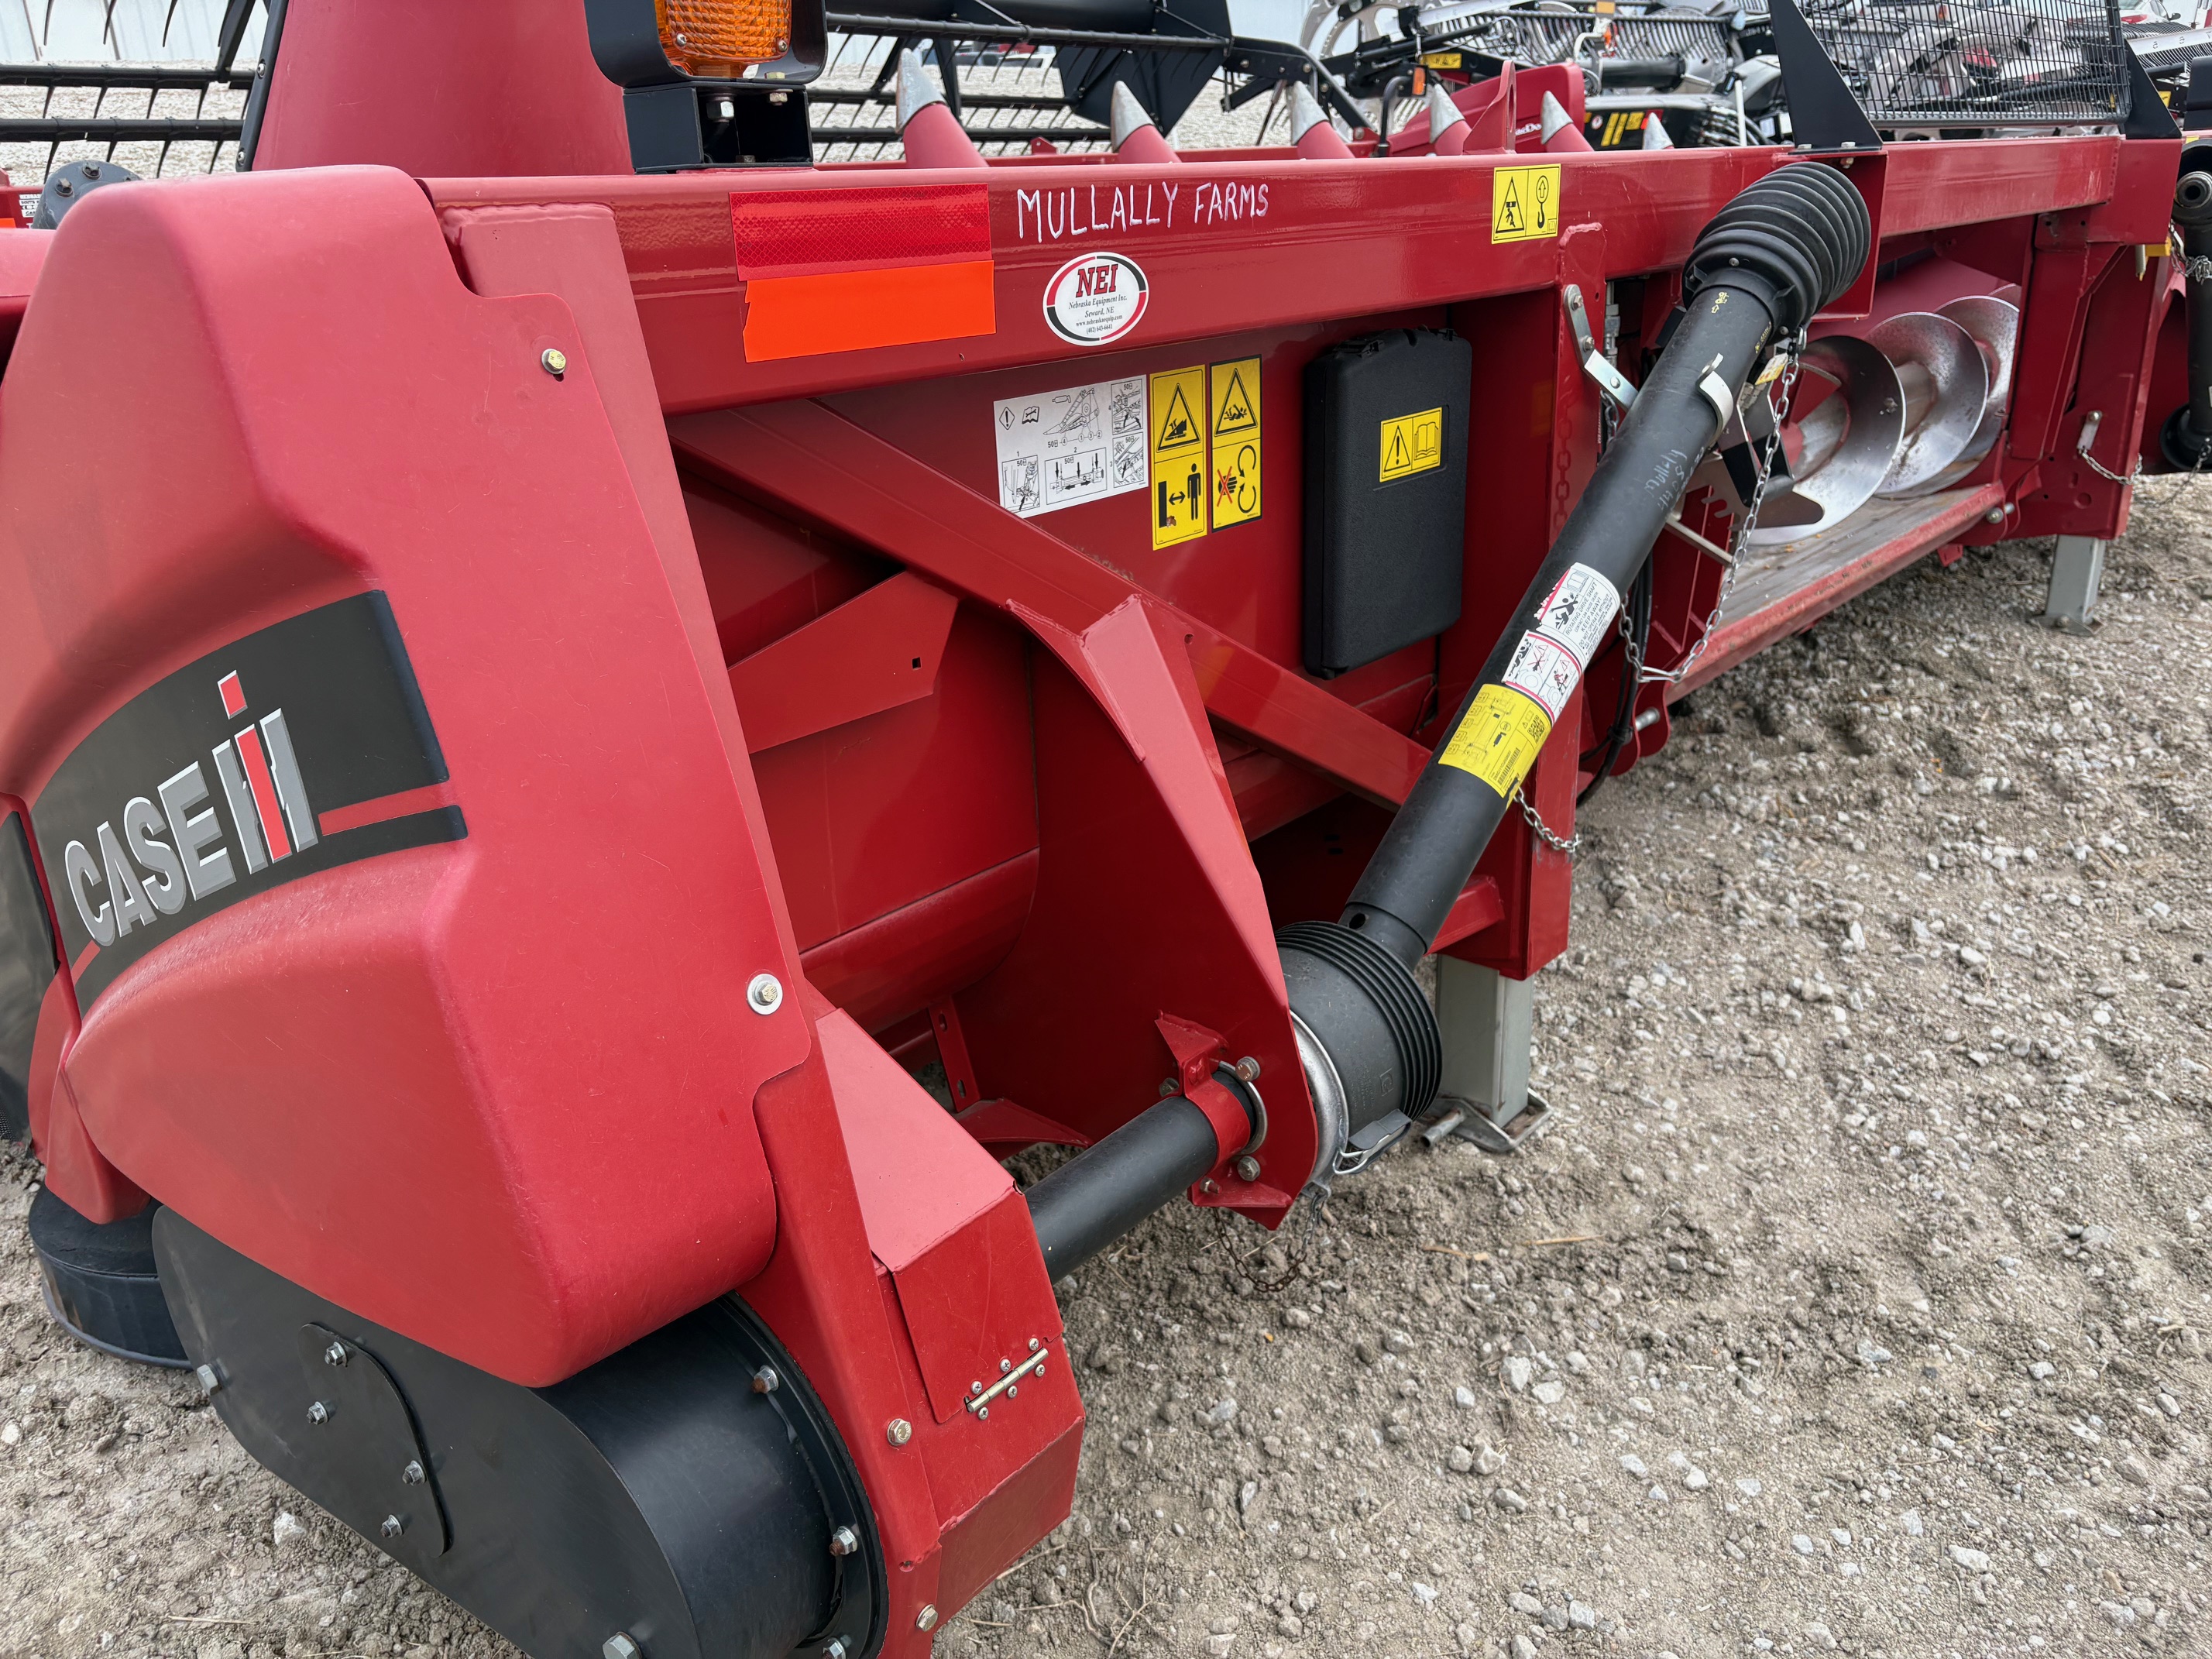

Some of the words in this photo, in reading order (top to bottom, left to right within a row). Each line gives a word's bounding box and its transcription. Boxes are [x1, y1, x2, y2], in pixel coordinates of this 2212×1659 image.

[1016, 180, 1180, 244] MULLALLY
[1194, 181, 1269, 225] FARMS
[1075, 263, 1118, 298] NEI
[1068, 298, 1091, 310] Nebraska
[1092, 294, 1118, 308] Equipment
[1084, 308, 1105, 318] Seward,
[1076, 314, 1123, 327] www.nebraskaequip.com
[1086, 326, 1096, 335] (402)
[1565, 611, 1580, 635] ROTATING
[1578, 597, 1589, 612] DRIVE
[1586, 582, 1597, 598] SHAFT
[1581, 615, 1591, 632] KEEP
[1590, 597, 1602, 617] AWAY!
[64, 761, 237, 946] CASE
